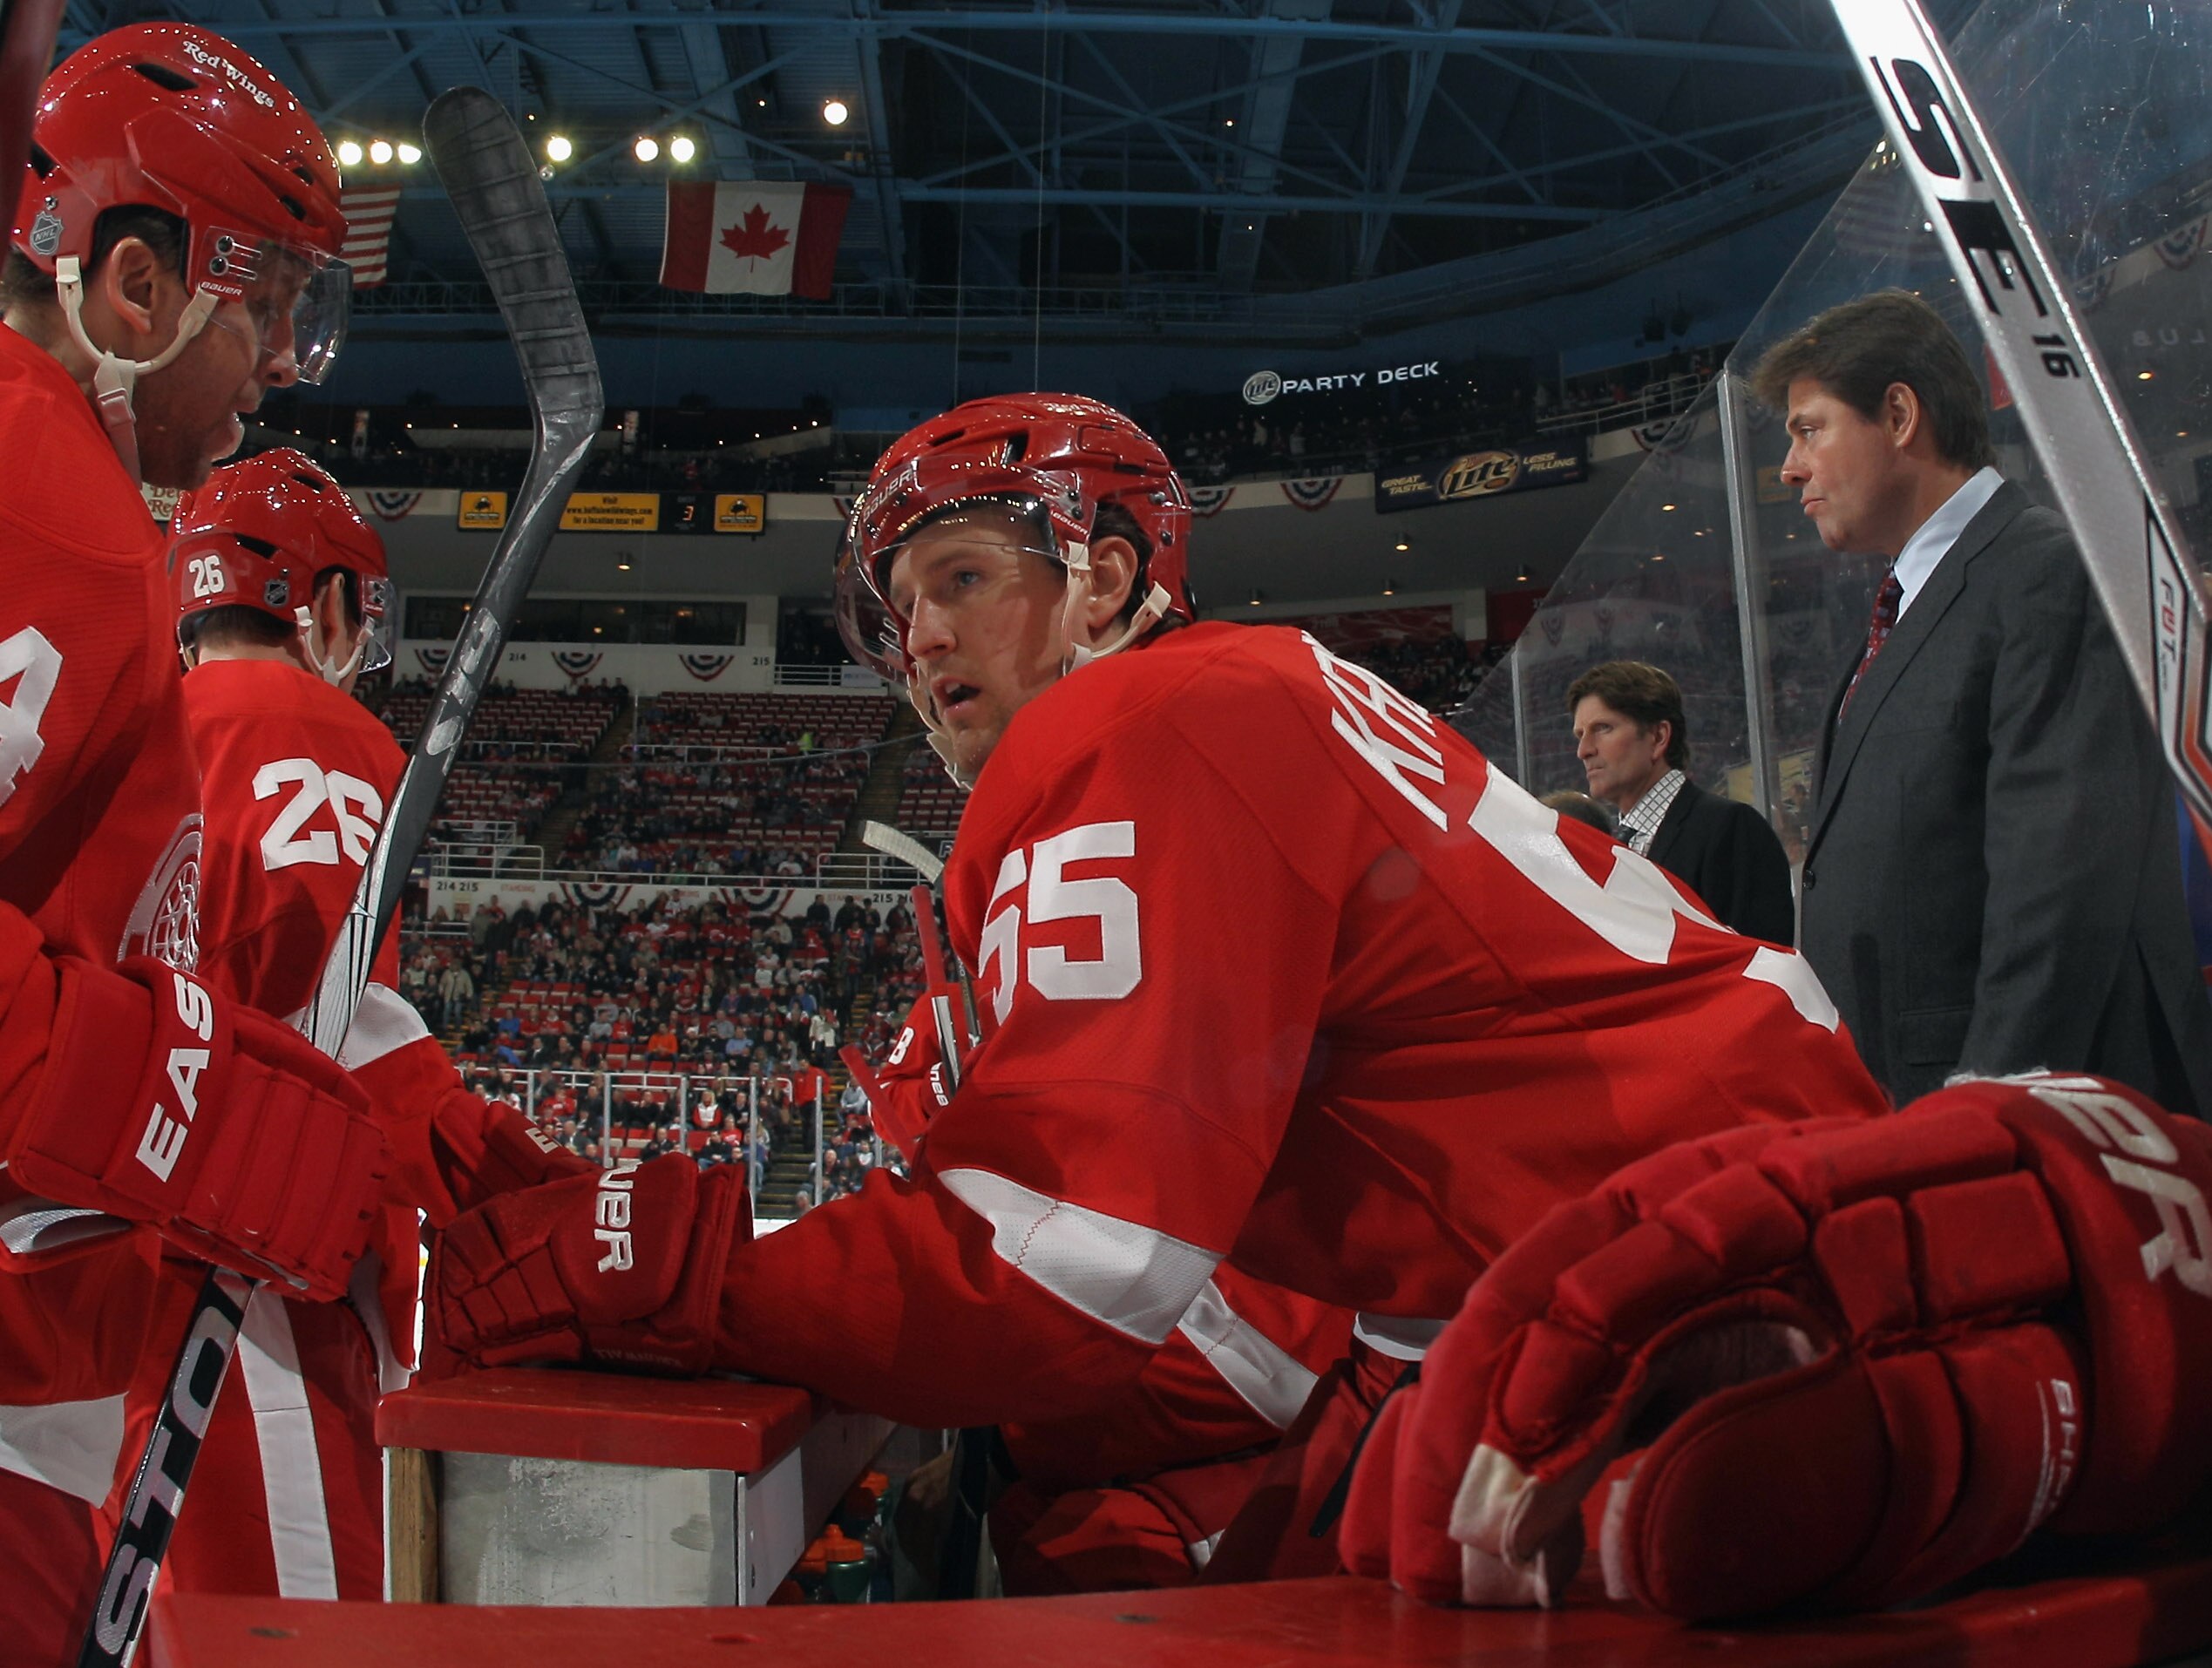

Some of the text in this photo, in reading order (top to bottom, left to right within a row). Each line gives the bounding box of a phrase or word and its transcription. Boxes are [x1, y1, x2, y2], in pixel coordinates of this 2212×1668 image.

[182, 40, 275, 108] Red Wings
[33, 227, 57, 242] NHL
[200, 281, 243, 296] BAUER
[1282, 372, 1366, 394] PARTY
[1377, 361, 1439, 384] DECK
[1523, 452, 1557, 464] LESS
[1529, 458, 1577, 472] FILLING
[1381, 475, 1423, 488] GREAT
[862, 468, 913, 523] BAUER
[682, 505, 695, 521] 3
[189, 555, 225, 598] 26
[509, 652, 526, 661] 214
[752, 656, 770, 666] 215
[252, 756, 383, 870] 26
[437, 880, 478, 892] 214 215
[872, 892, 893, 904] 215
[978, 820, 1143, 1027] 55
